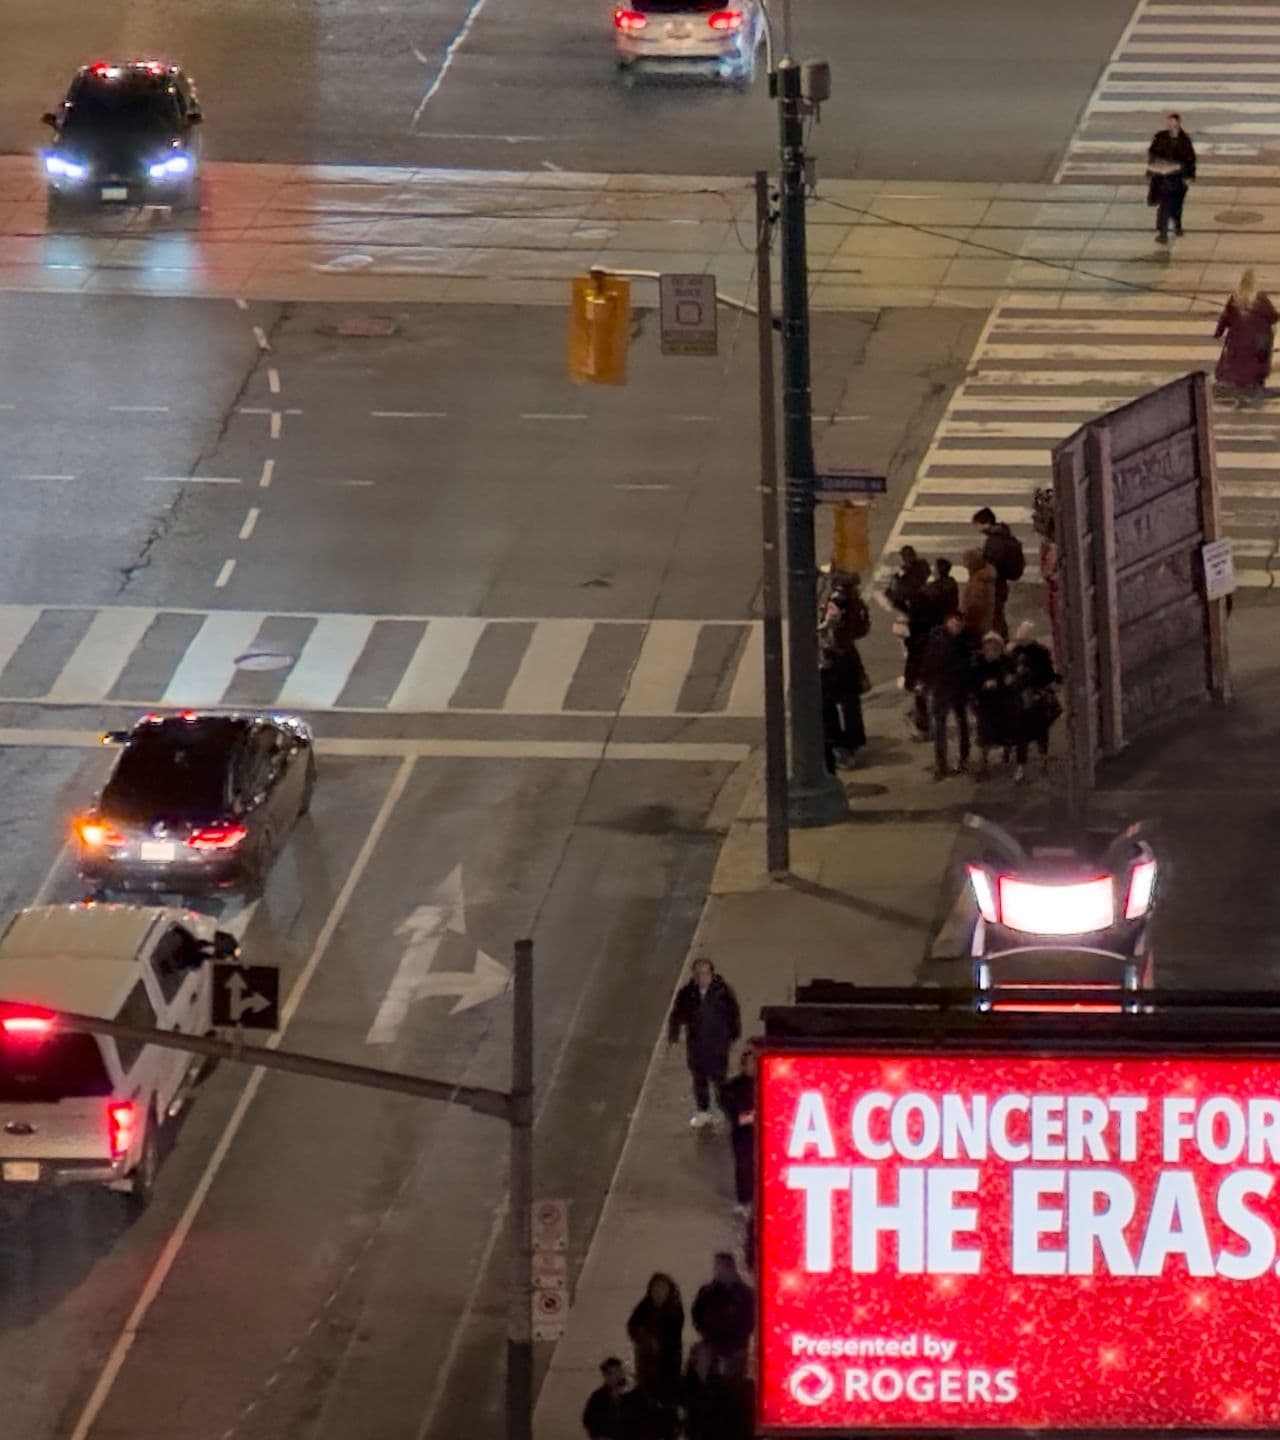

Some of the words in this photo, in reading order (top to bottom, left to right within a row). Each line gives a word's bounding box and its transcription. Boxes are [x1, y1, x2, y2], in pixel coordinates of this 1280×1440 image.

[788, 1094, 836, 1158] A
[851, 1092, 1148, 1162] CONCERT
[786, 1166, 981, 1274] THE
[792, 1334, 918, 1358] Presented
[923, 1335, 956, 1361] by
[844, 1368, 1018, 1403] ROGERS
